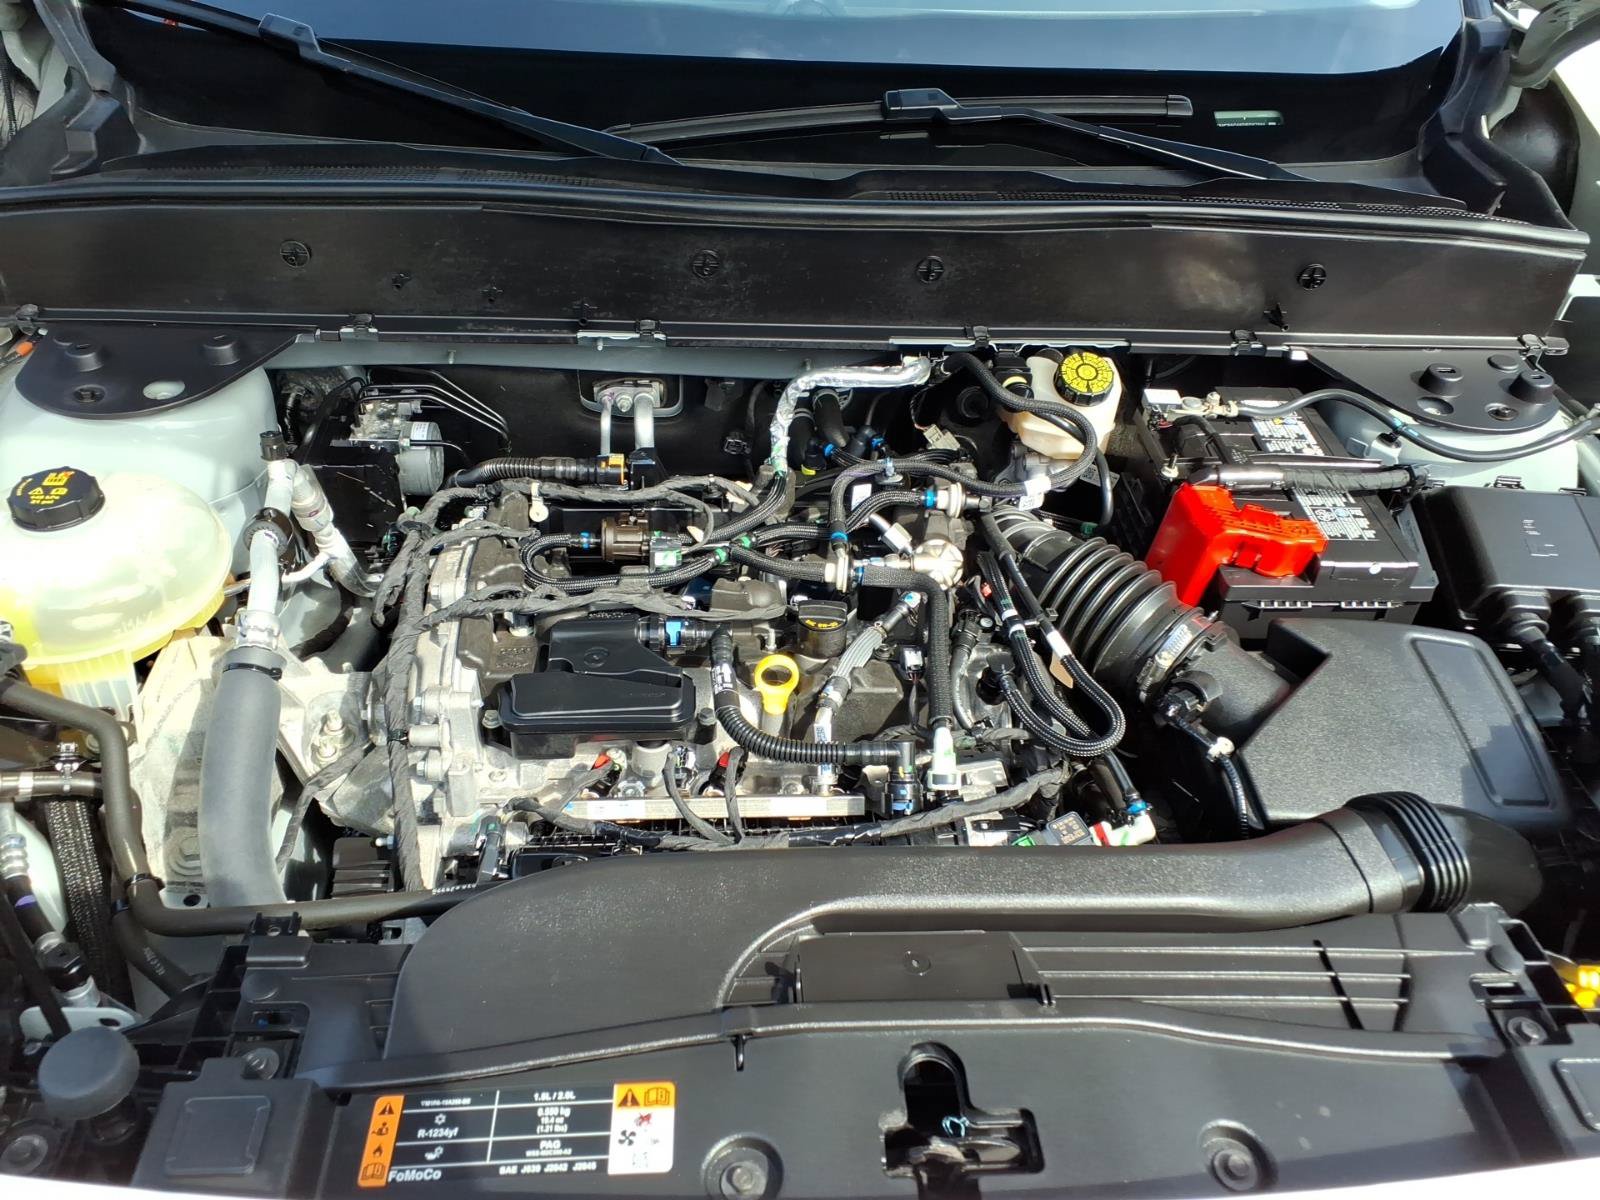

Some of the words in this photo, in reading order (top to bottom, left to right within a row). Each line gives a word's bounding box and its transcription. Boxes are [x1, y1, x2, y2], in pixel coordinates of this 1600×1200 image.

[417, 1126, 459, 1139] R-1234yf
[539, 1139, 561, 1150] PAG
[387, 1168, 442, 1183] FoMoCo
